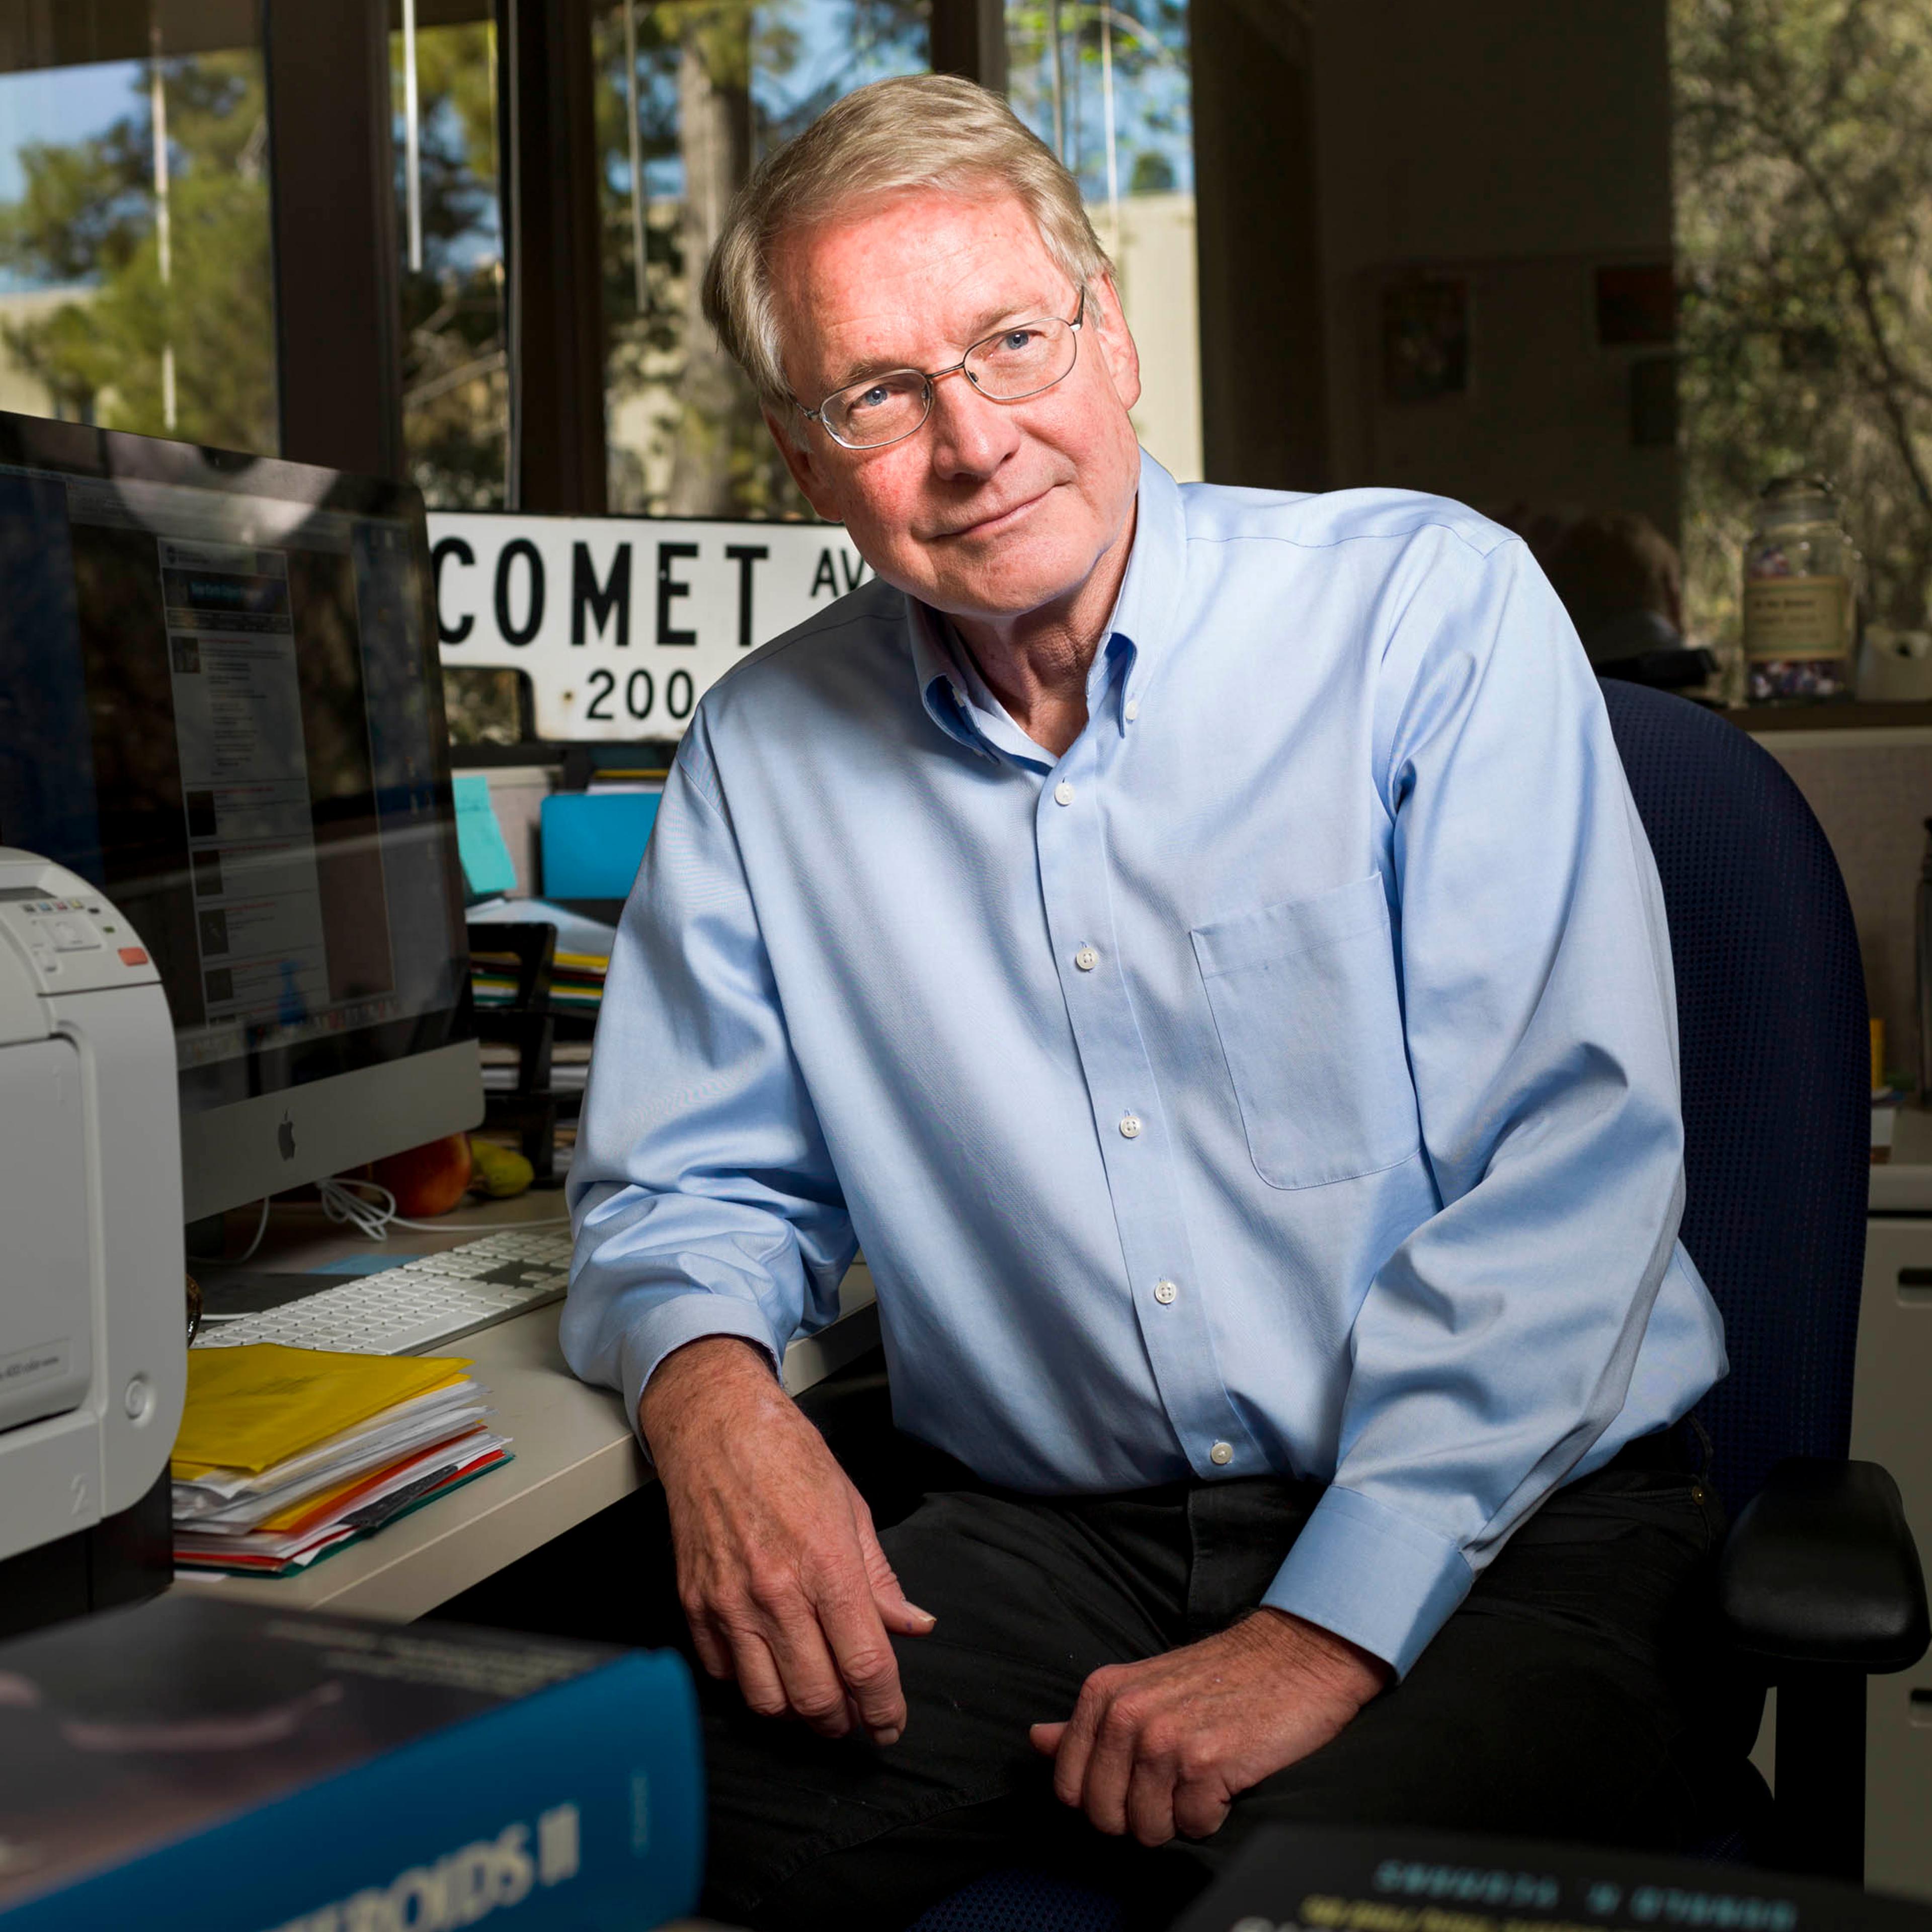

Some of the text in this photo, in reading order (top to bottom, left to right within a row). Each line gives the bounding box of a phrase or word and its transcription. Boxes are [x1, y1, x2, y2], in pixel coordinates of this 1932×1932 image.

[432, 537, 865, 647] COMET AV
[587, 669, 694, 719] 200
